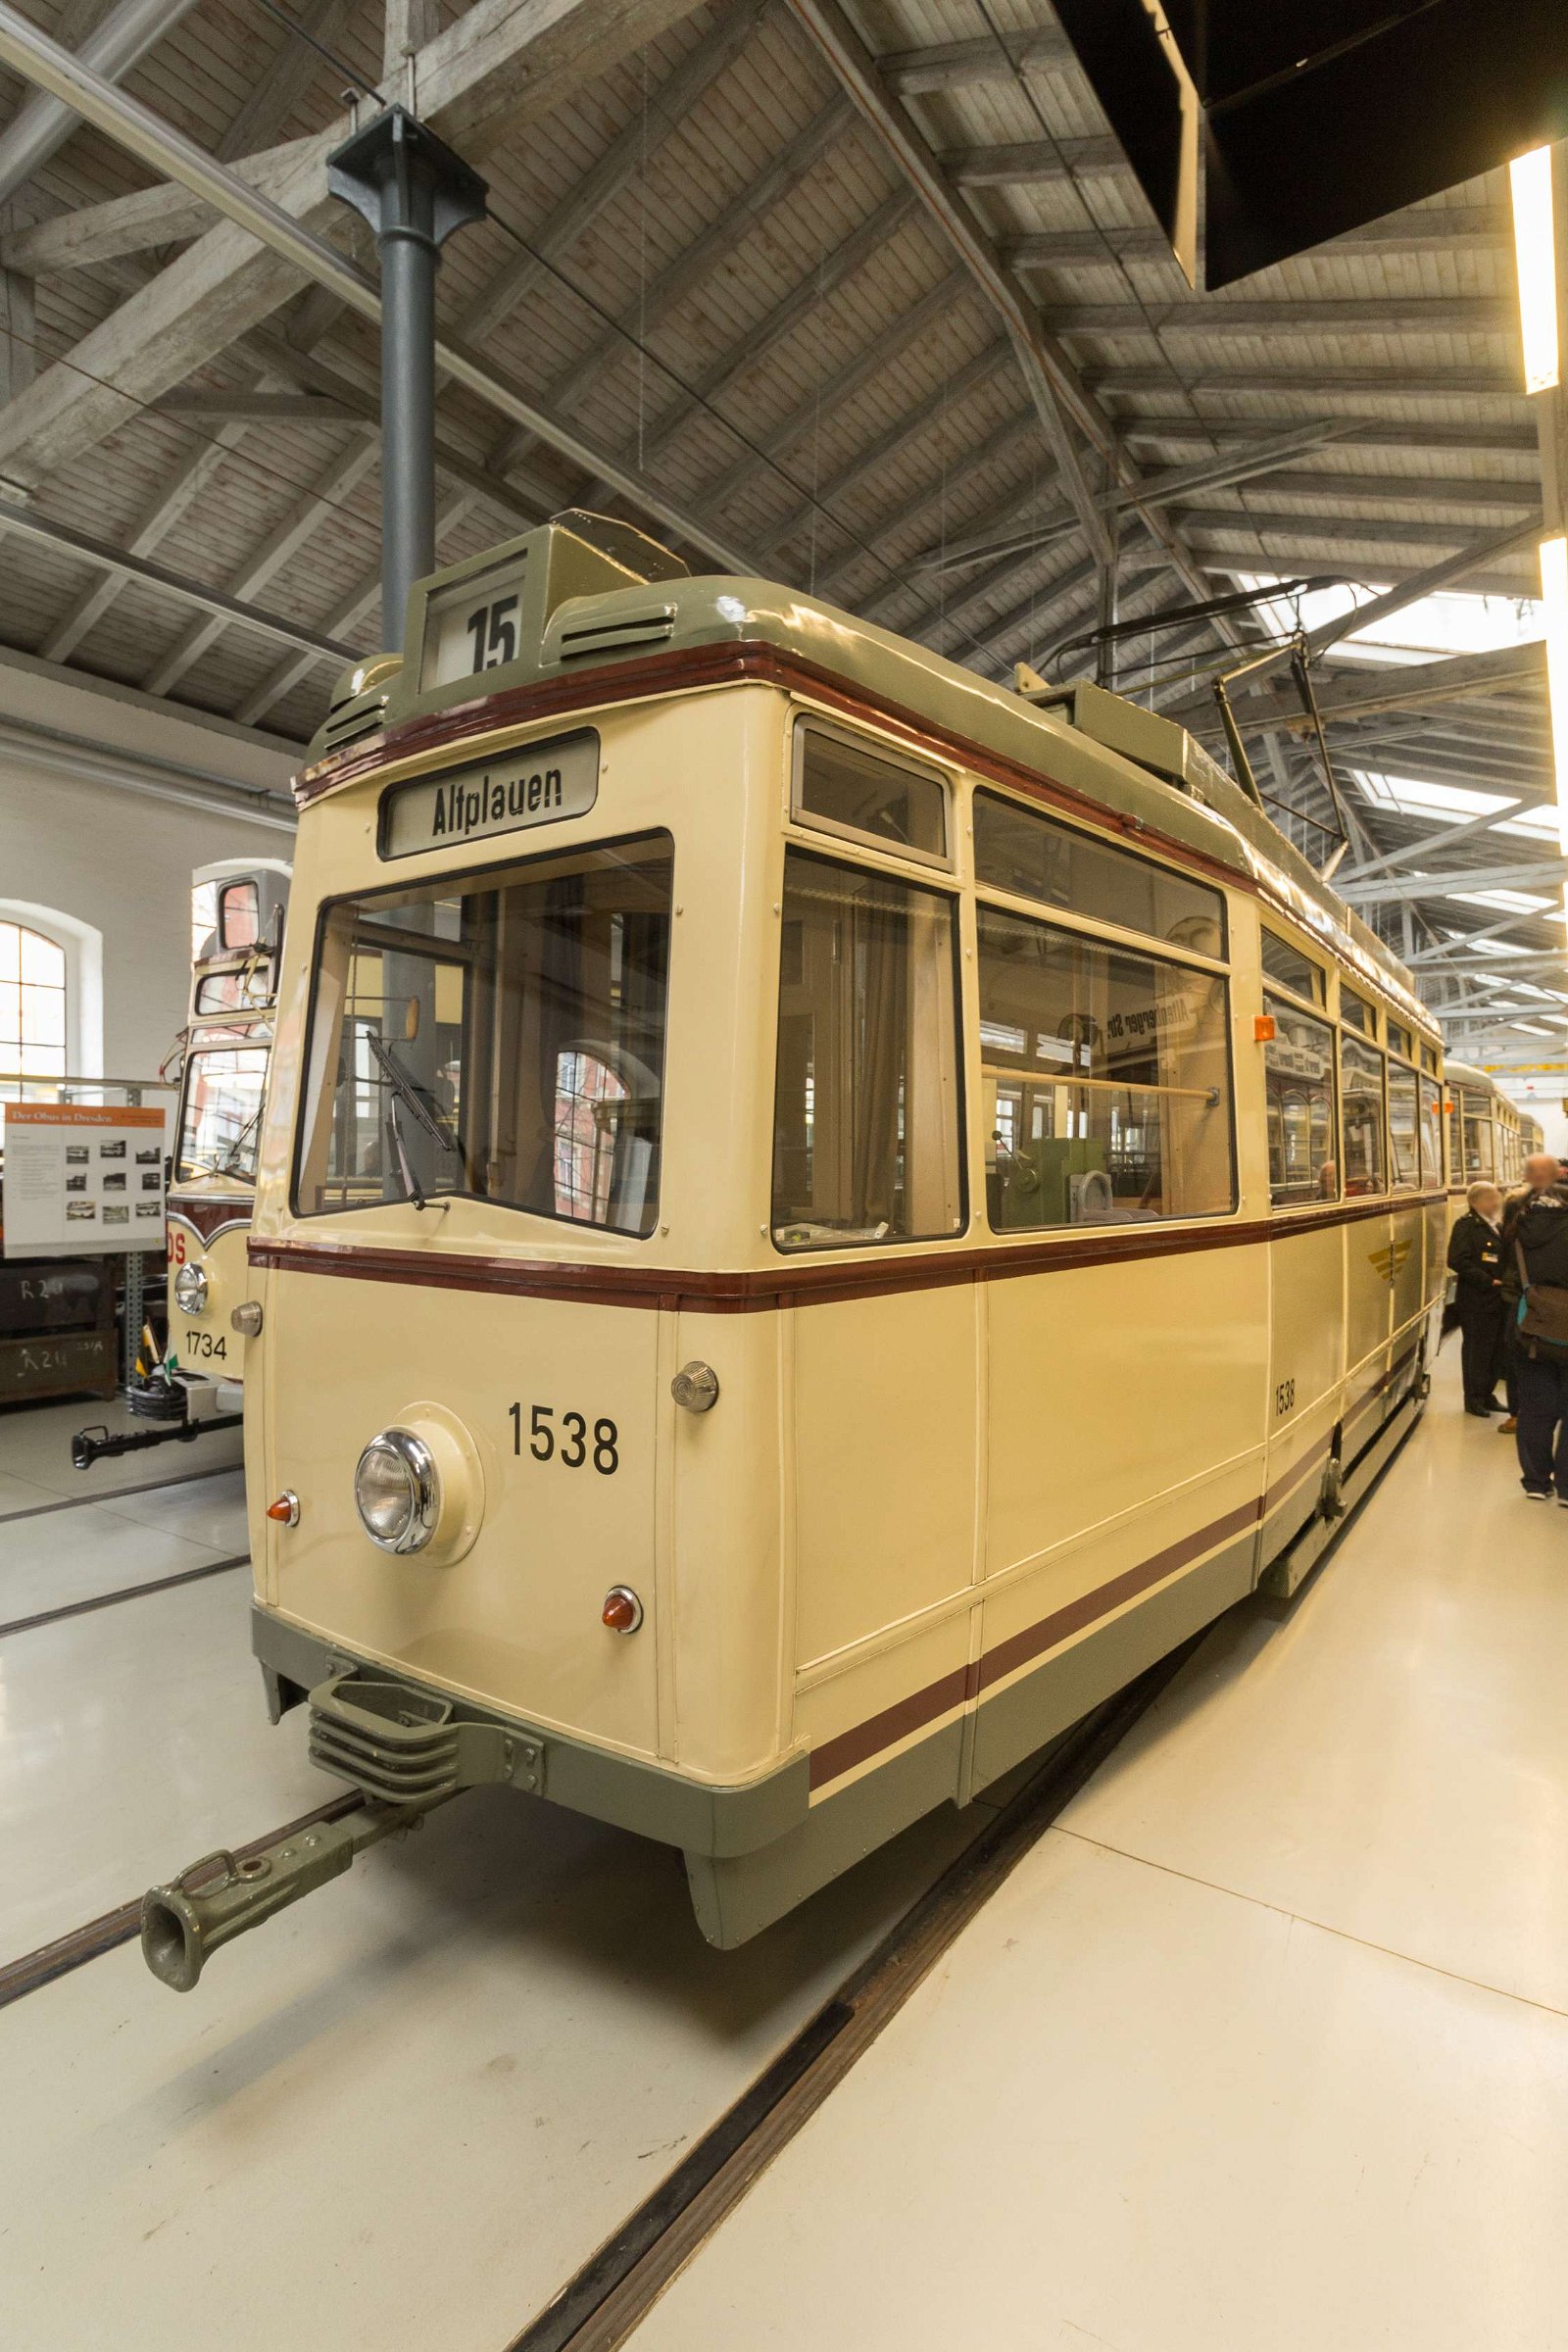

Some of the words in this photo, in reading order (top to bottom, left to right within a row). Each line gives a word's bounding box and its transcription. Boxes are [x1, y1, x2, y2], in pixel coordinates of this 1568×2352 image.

[466, 594, 519, 675] 15
[432, 767, 563, 836] Altplauen
[12, 1110, 31, 1120] Der
[62, 1112, 72, 1121] in
[74, 1112, 112, 1123] Dresden
[186, 1331, 227, 1360] 1734
[1275, 1377, 1295, 1417] 1538
[509, 1401, 619, 1476] 1538
